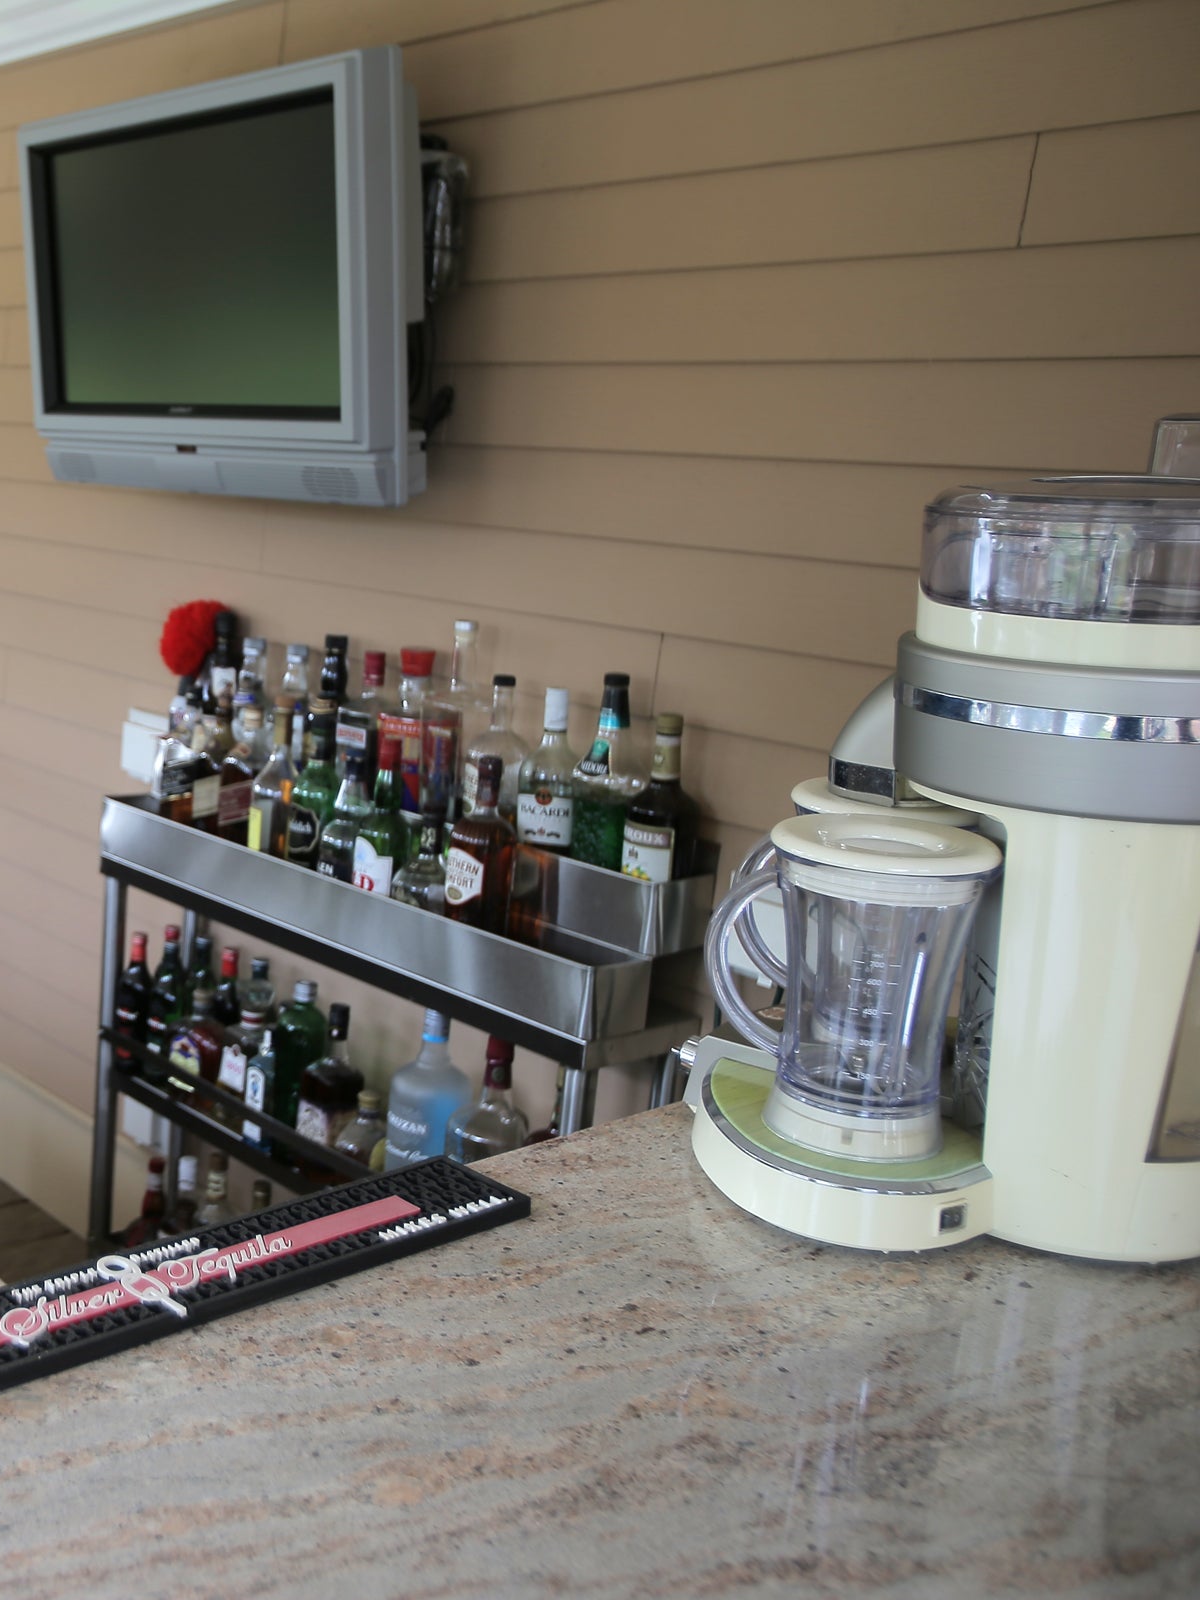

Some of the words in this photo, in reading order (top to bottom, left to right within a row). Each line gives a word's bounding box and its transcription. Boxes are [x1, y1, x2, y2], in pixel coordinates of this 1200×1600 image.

[520, 803, 571, 818] BACARDI
[377, 1212, 448, 1242] MIXES
[157, 1233, 294, 1293] Tequila
